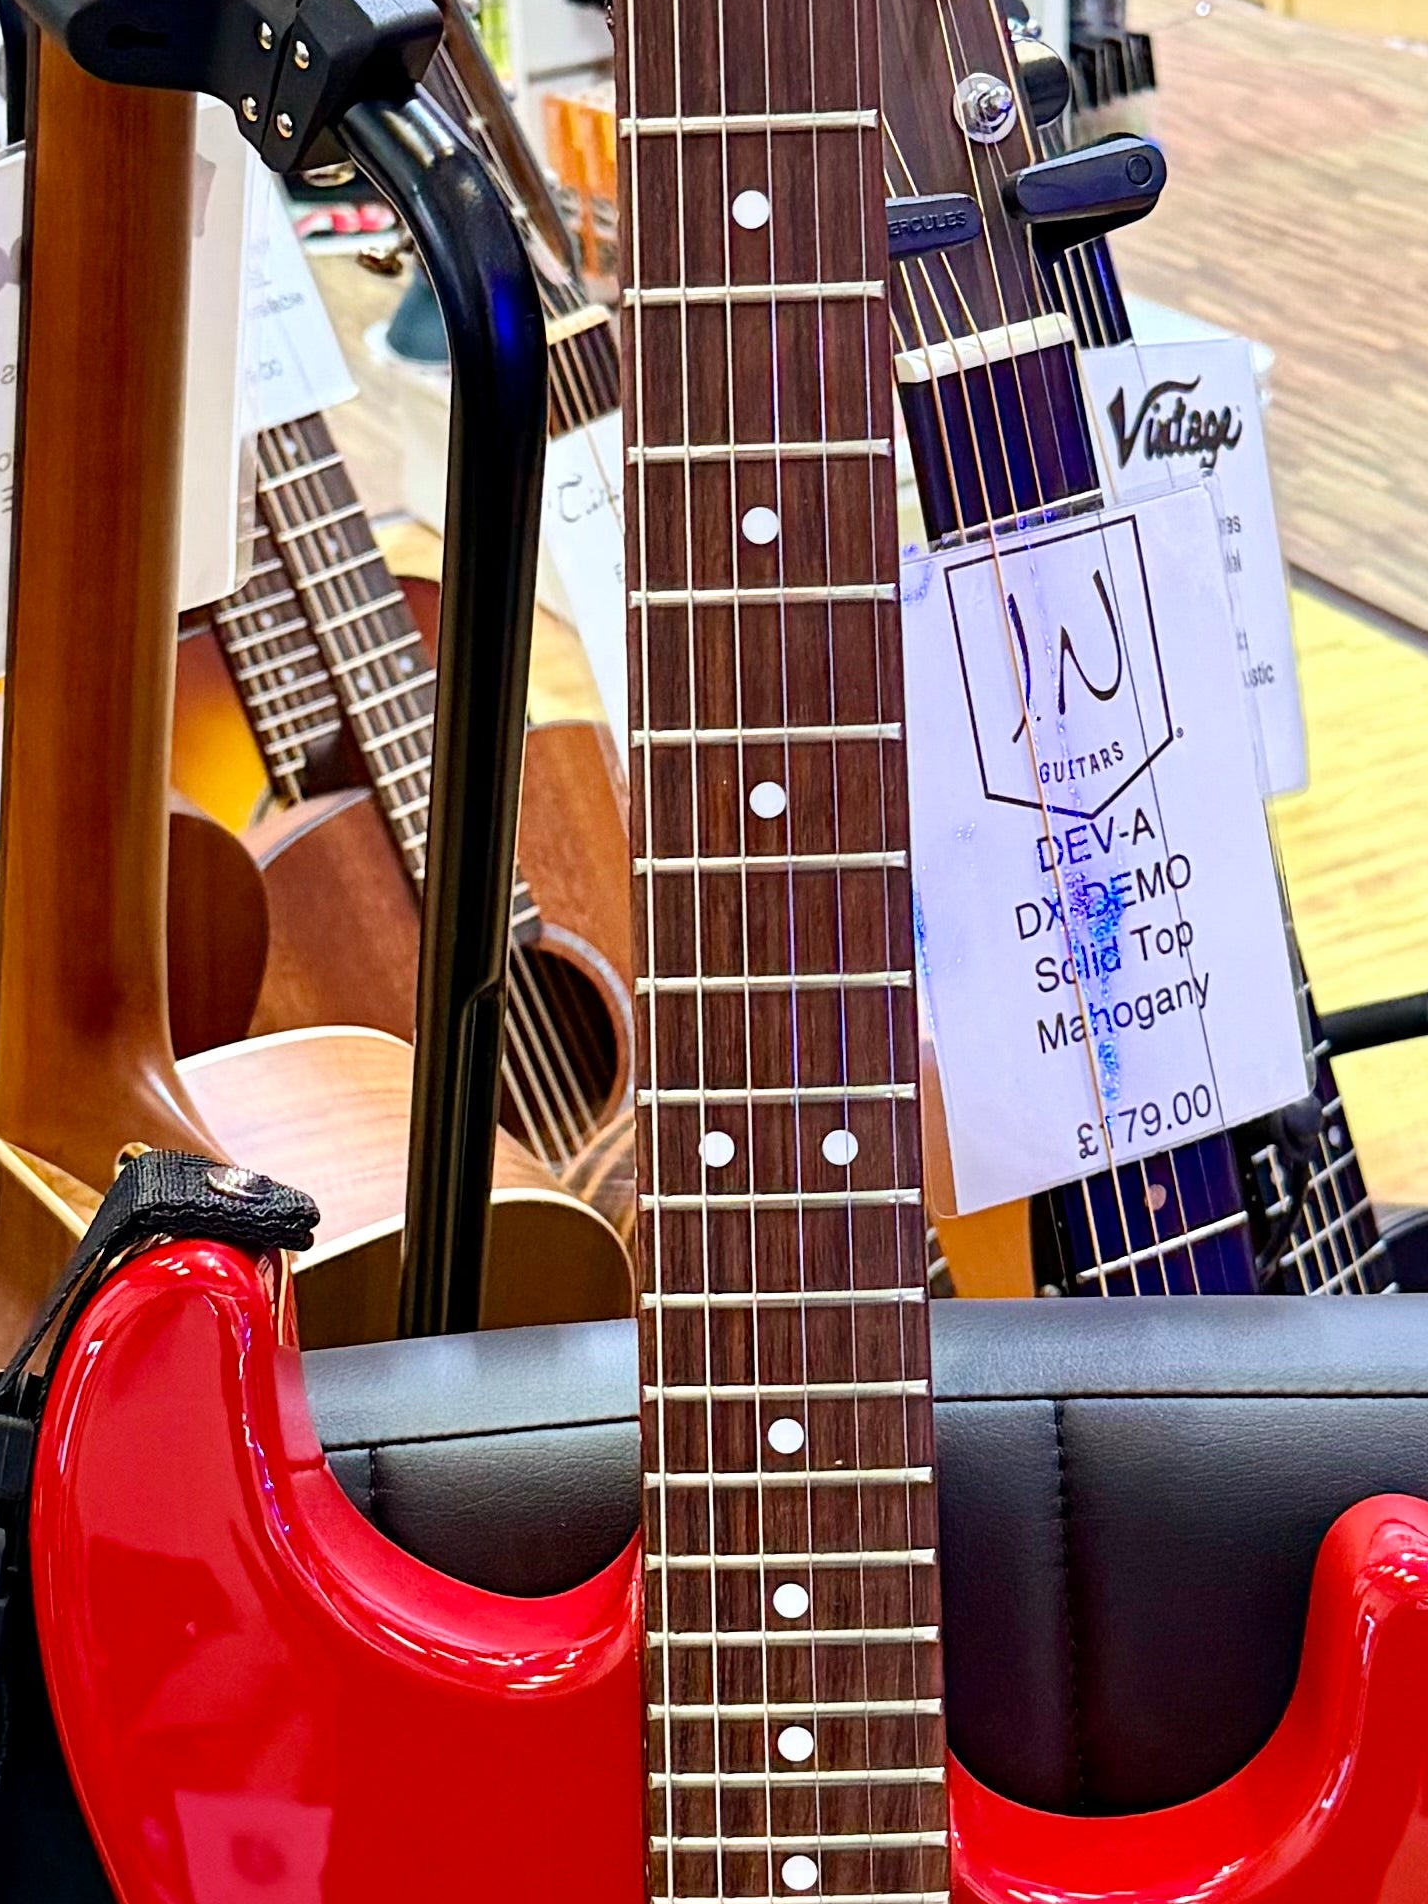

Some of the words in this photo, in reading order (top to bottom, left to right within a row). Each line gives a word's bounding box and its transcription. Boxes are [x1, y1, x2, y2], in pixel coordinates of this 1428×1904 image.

[888, 210, 965, 236] ERCULES
[1107, 375, 1242, 477] Vintage
[1038, 741, 1124, 784] GUITARS
[1036, 807, 1155, 873] DEV-A
[1035, 937, 1121, 993] Solid
[1130, 920, 1193, 960] Top
[1037, 972, 1209, 1053] Mahogany
[1077, 1084, 1212, 1159] £179.00
